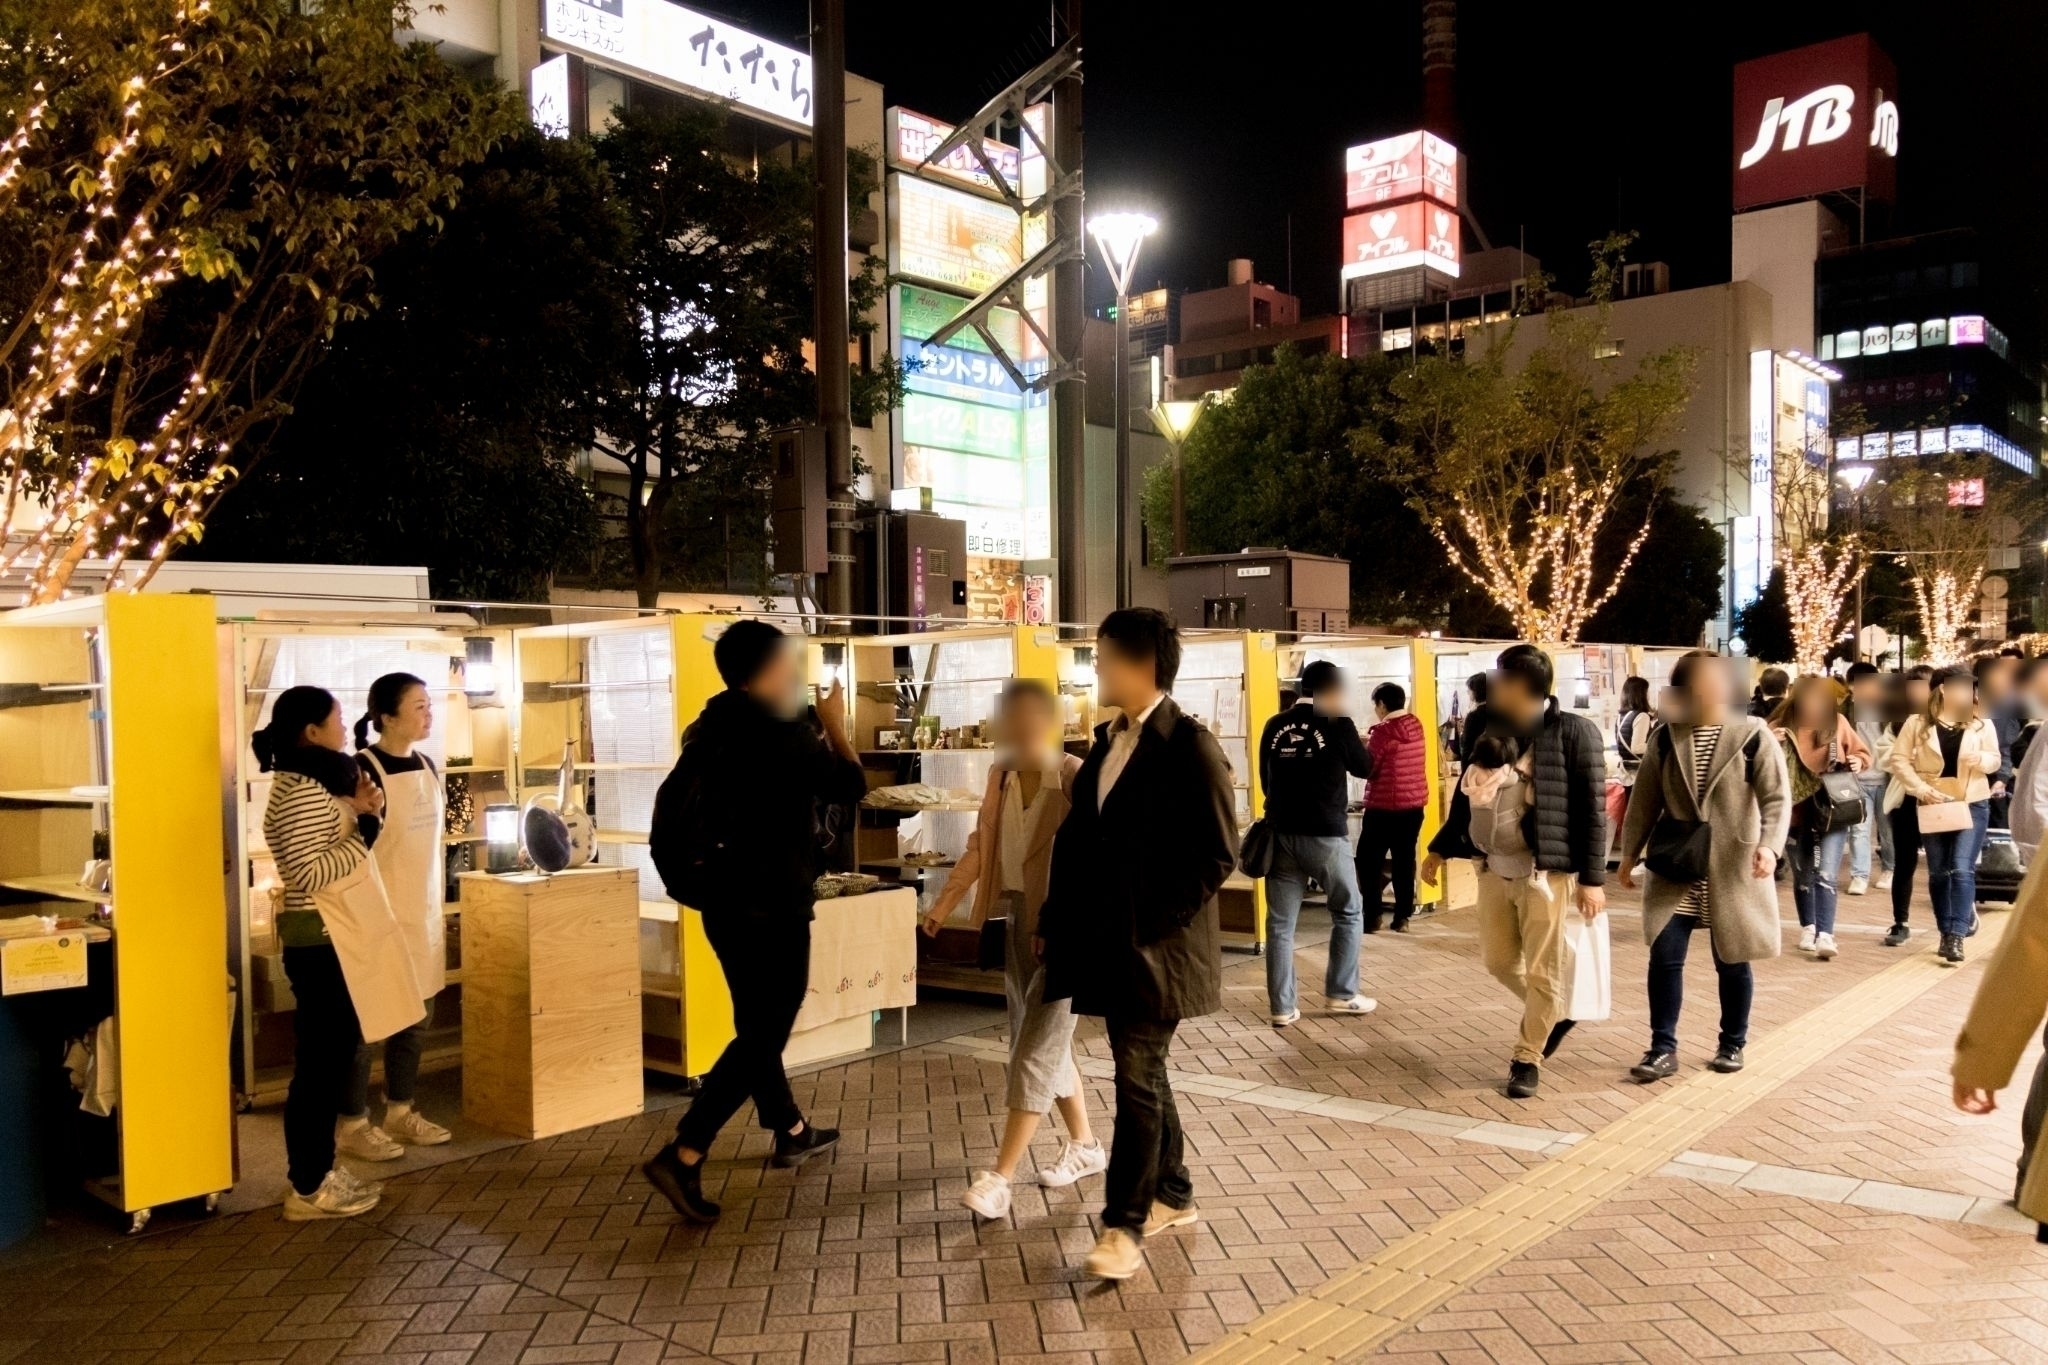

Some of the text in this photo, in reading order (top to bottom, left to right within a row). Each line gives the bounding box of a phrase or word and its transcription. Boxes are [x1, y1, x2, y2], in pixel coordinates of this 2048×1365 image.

[688, 24, 811, 118] たたら
[1739, 84, 1855, 170] JTB
[1360, 161, 1409, 189] アコム
[1427, 158, 1453, 187] アコム
[1357, 235, 1410, 261] アイフル
[1428, 234, 1456, 260] アイフル
[905, 308, 942, 322] エステ
[1864, 325, 1945, 348] ハウスメイト
[920, 347, 1005, 386] セントラル
[968, 534, 1022, 556] 即日修理
[1301, 723, 1326, 750] MRINA
